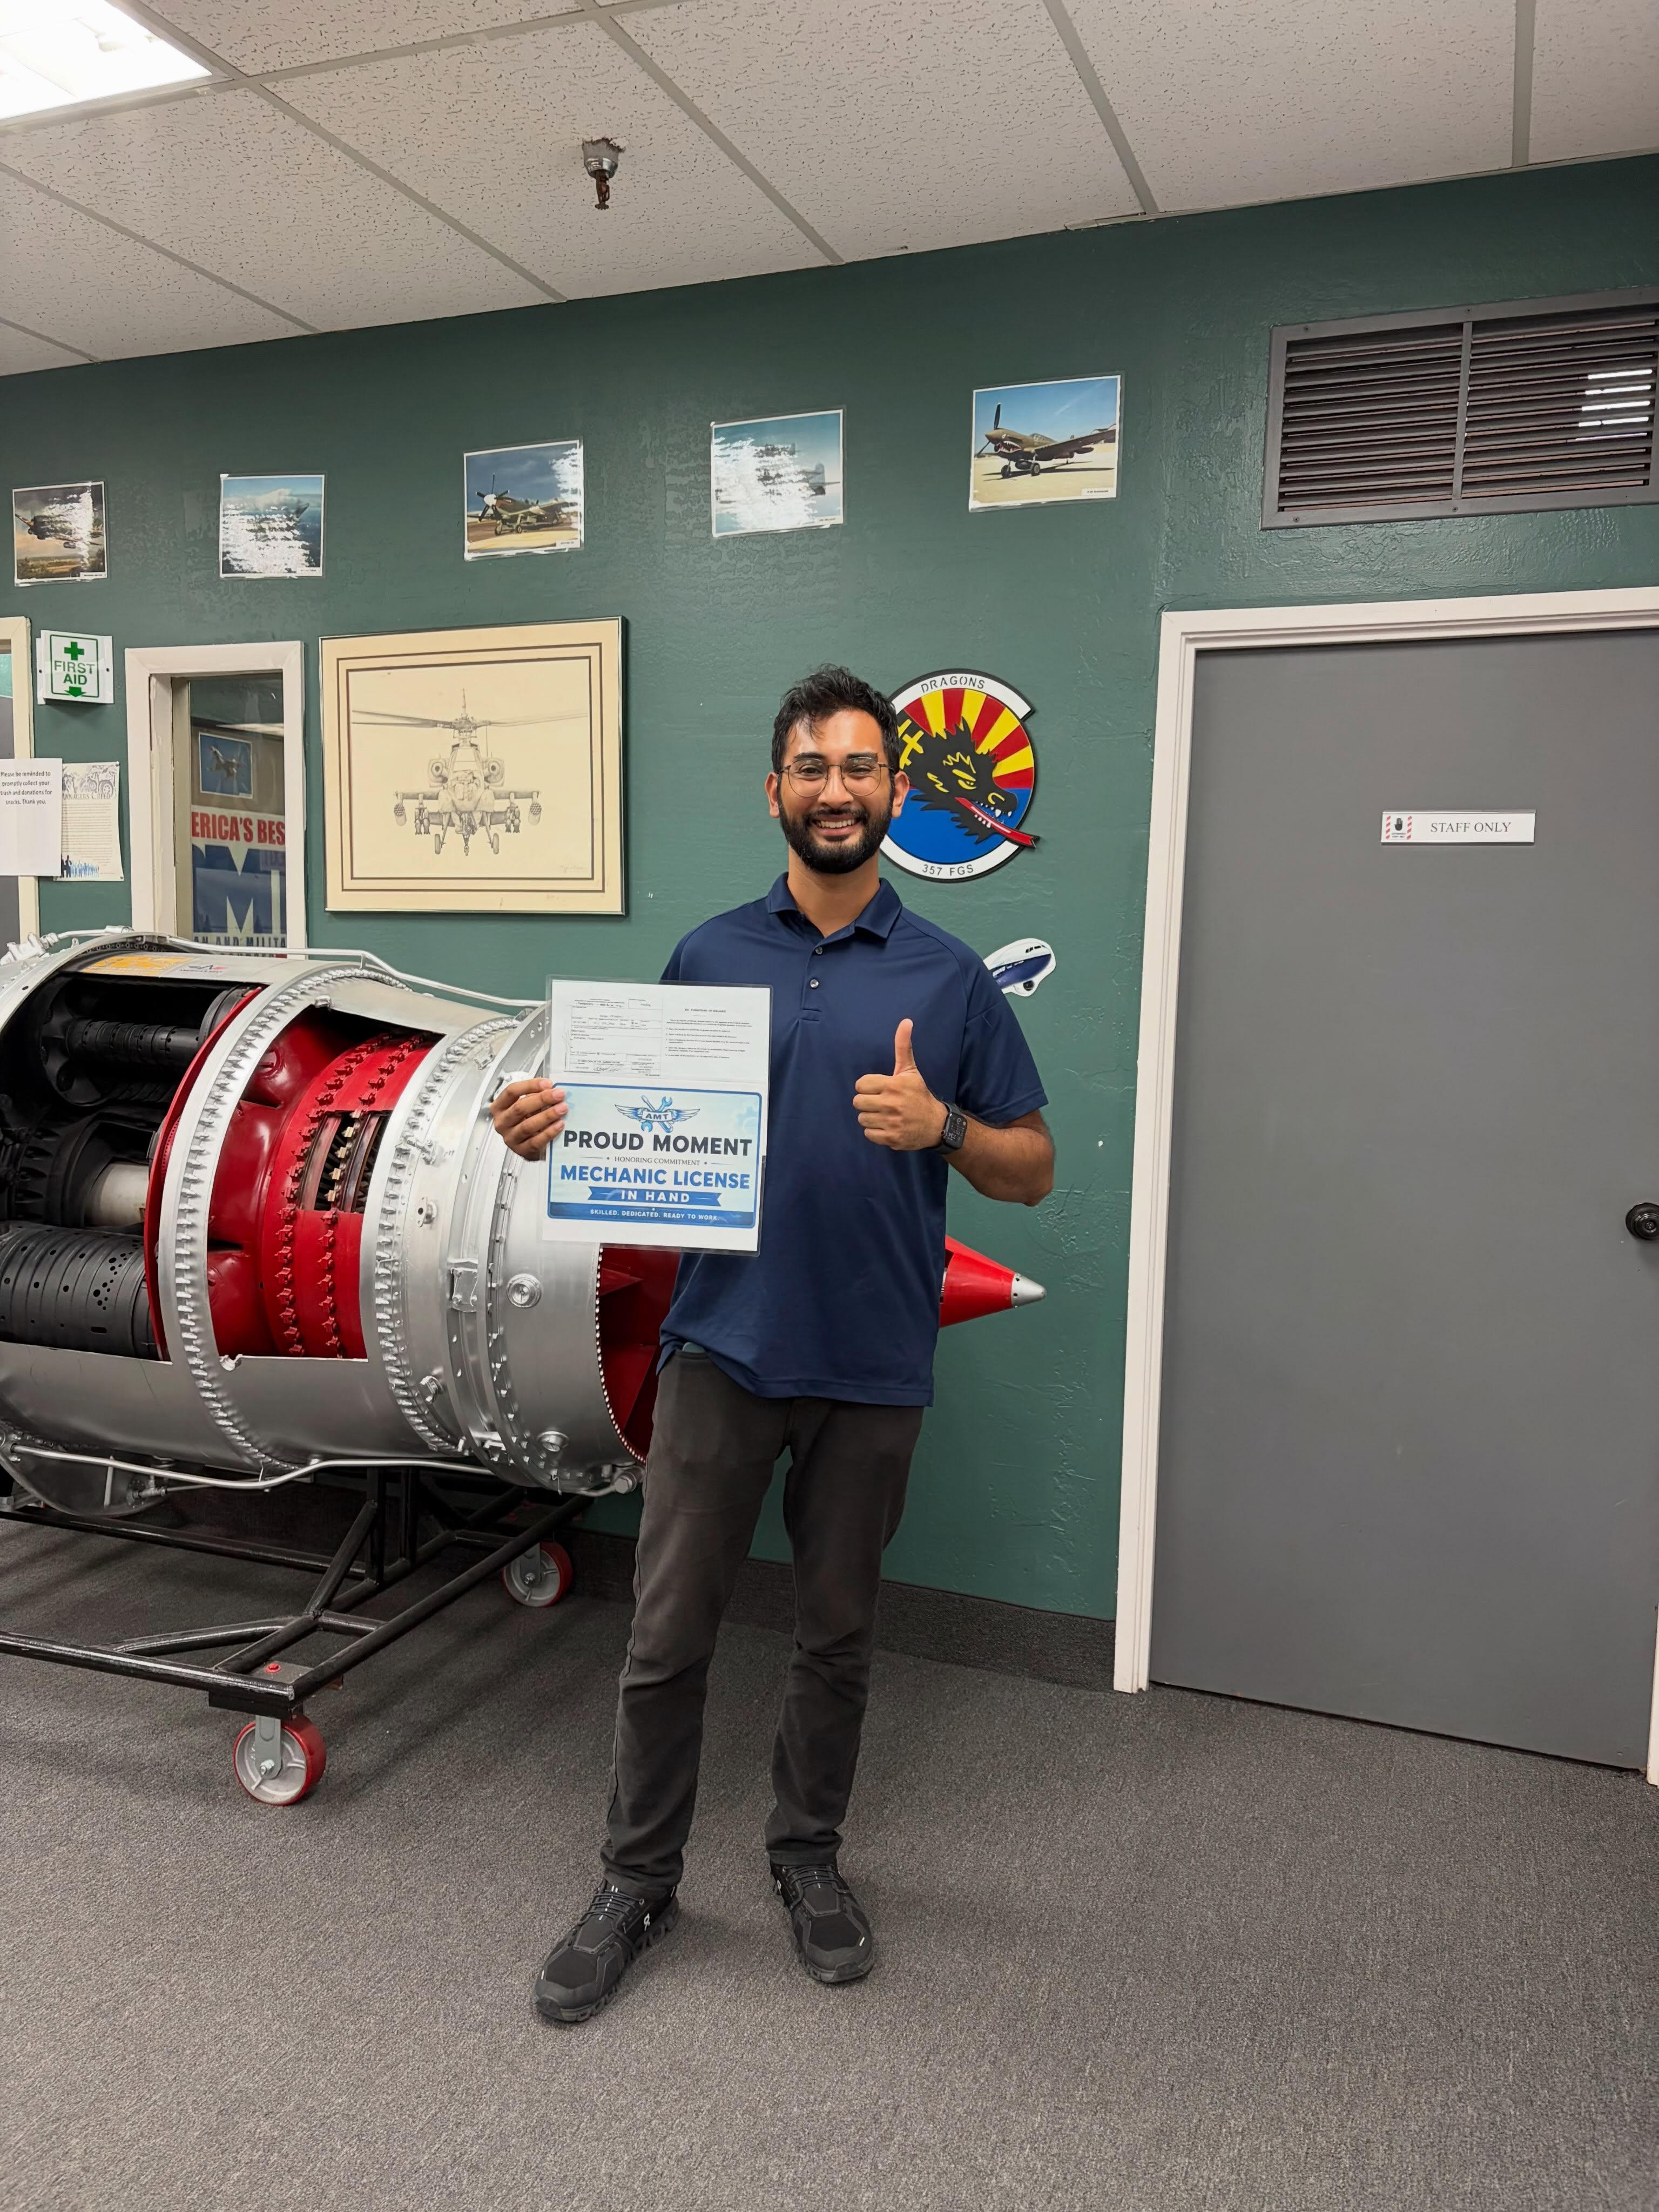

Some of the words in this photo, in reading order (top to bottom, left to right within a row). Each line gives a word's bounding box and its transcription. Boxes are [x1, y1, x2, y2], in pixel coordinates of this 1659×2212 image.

[54, 660, 95, 675] FIRST
[63, 673, 87, 685] AID
[921, 676, 985, 693] DRAGONS
[191, 811, 254, 842] ERICA'S
[257, 819, 286, 846] BES
[1431, 822, 1471, 833] STAFF
[1474, 822, 1512, 833] ONLY
[922, 864, 942, 875] 357
[949, 864, 974, 876] FGS
[563, 1130, 644, 1150] PROUD
[653, 1134, 752, 1156] MOMENT
[614, 1156, 653, 1164] HONORING
[653, 1158, 700, 1166] COMMITMENT
[561, 1164, 667, 1185] MECHANIC
[673, 1170, 750, 1189] LICENSE
[621, 1190, 637, 1201] IN
[645, 1191, 690, 1203] HAND
